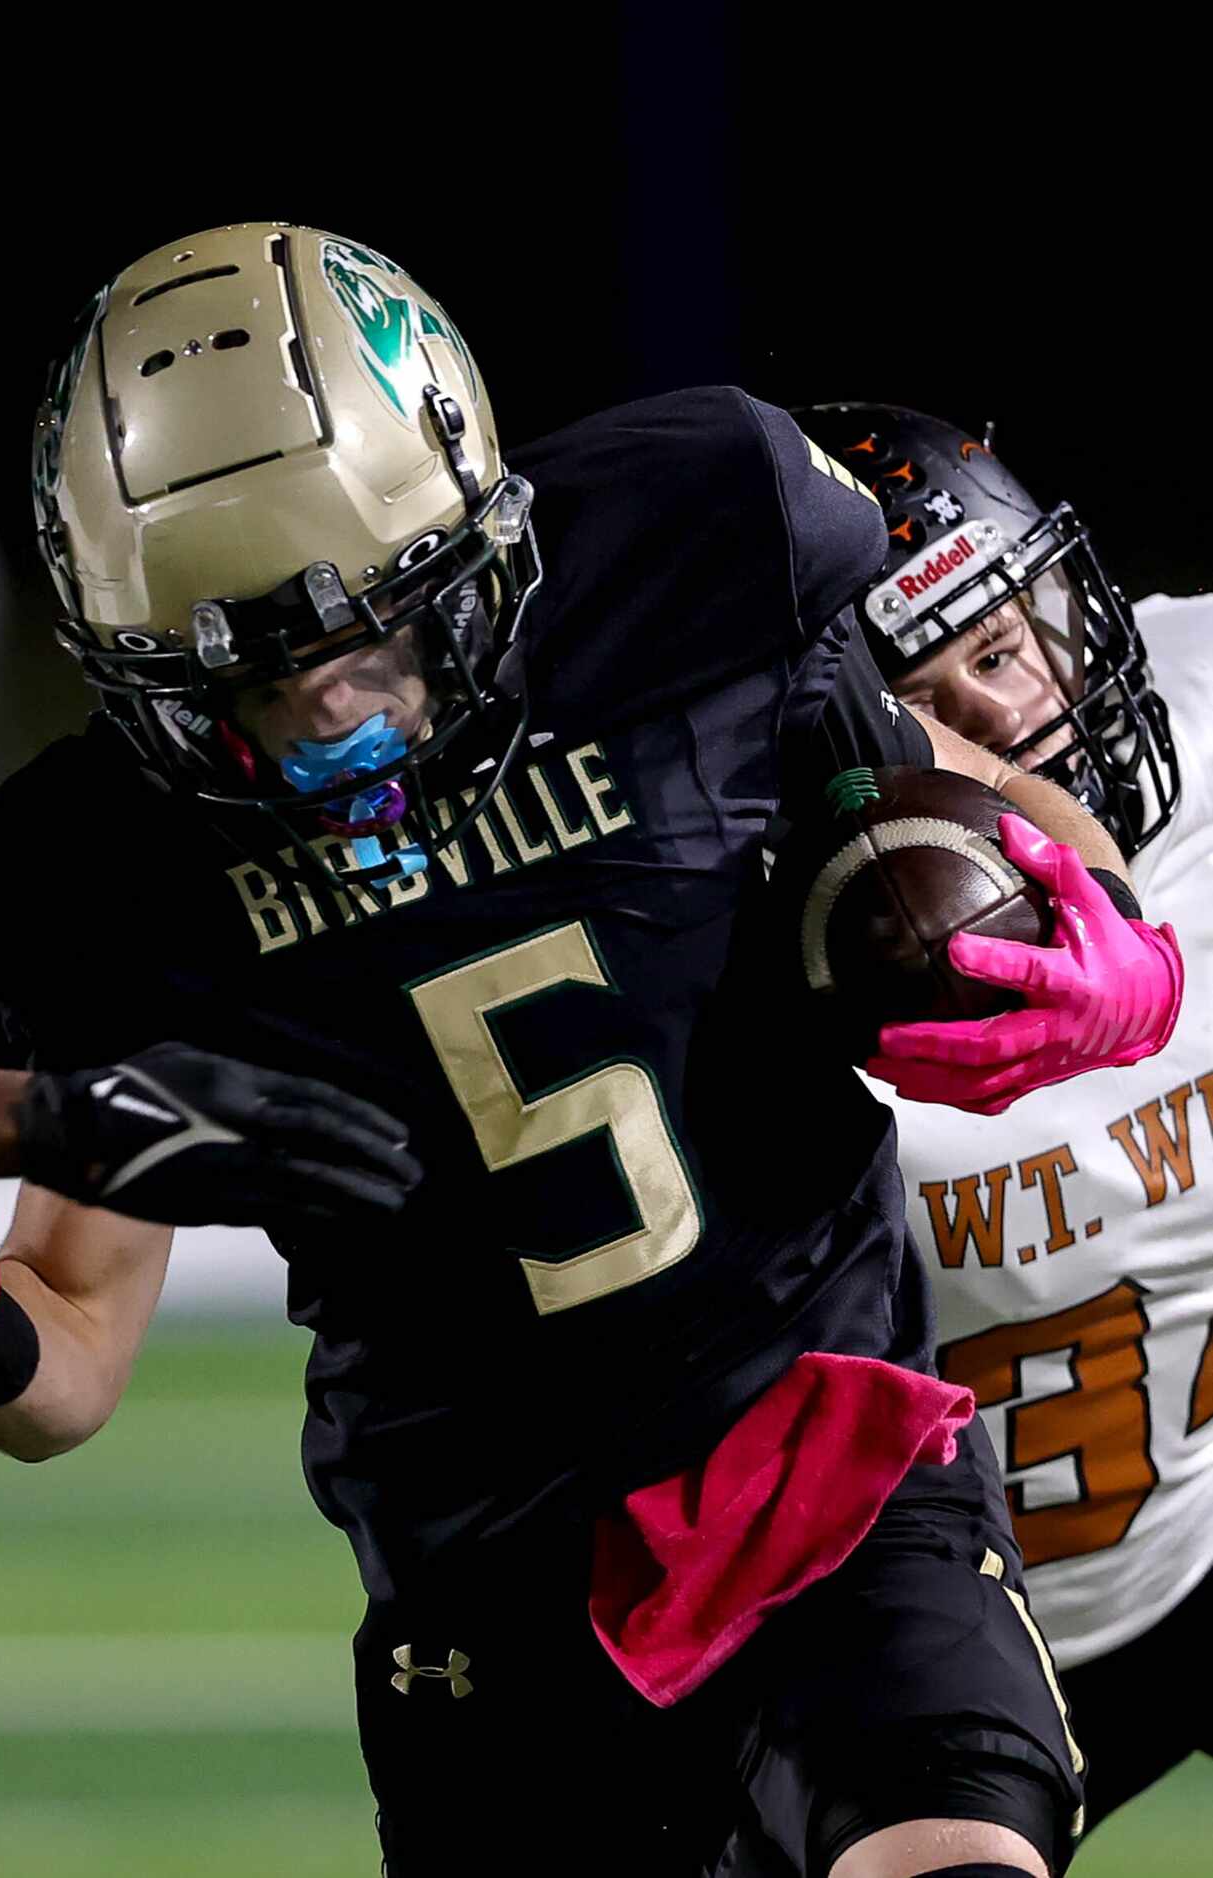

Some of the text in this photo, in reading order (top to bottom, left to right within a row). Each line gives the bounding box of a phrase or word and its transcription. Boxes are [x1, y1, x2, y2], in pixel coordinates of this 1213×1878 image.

[897, 534, 975, 600] Riddell
[401, 917, 706, 1316] 5
[919, 1070, 1213, 1269] W.T. W
[936, 1276, 1213, 1568] 3
